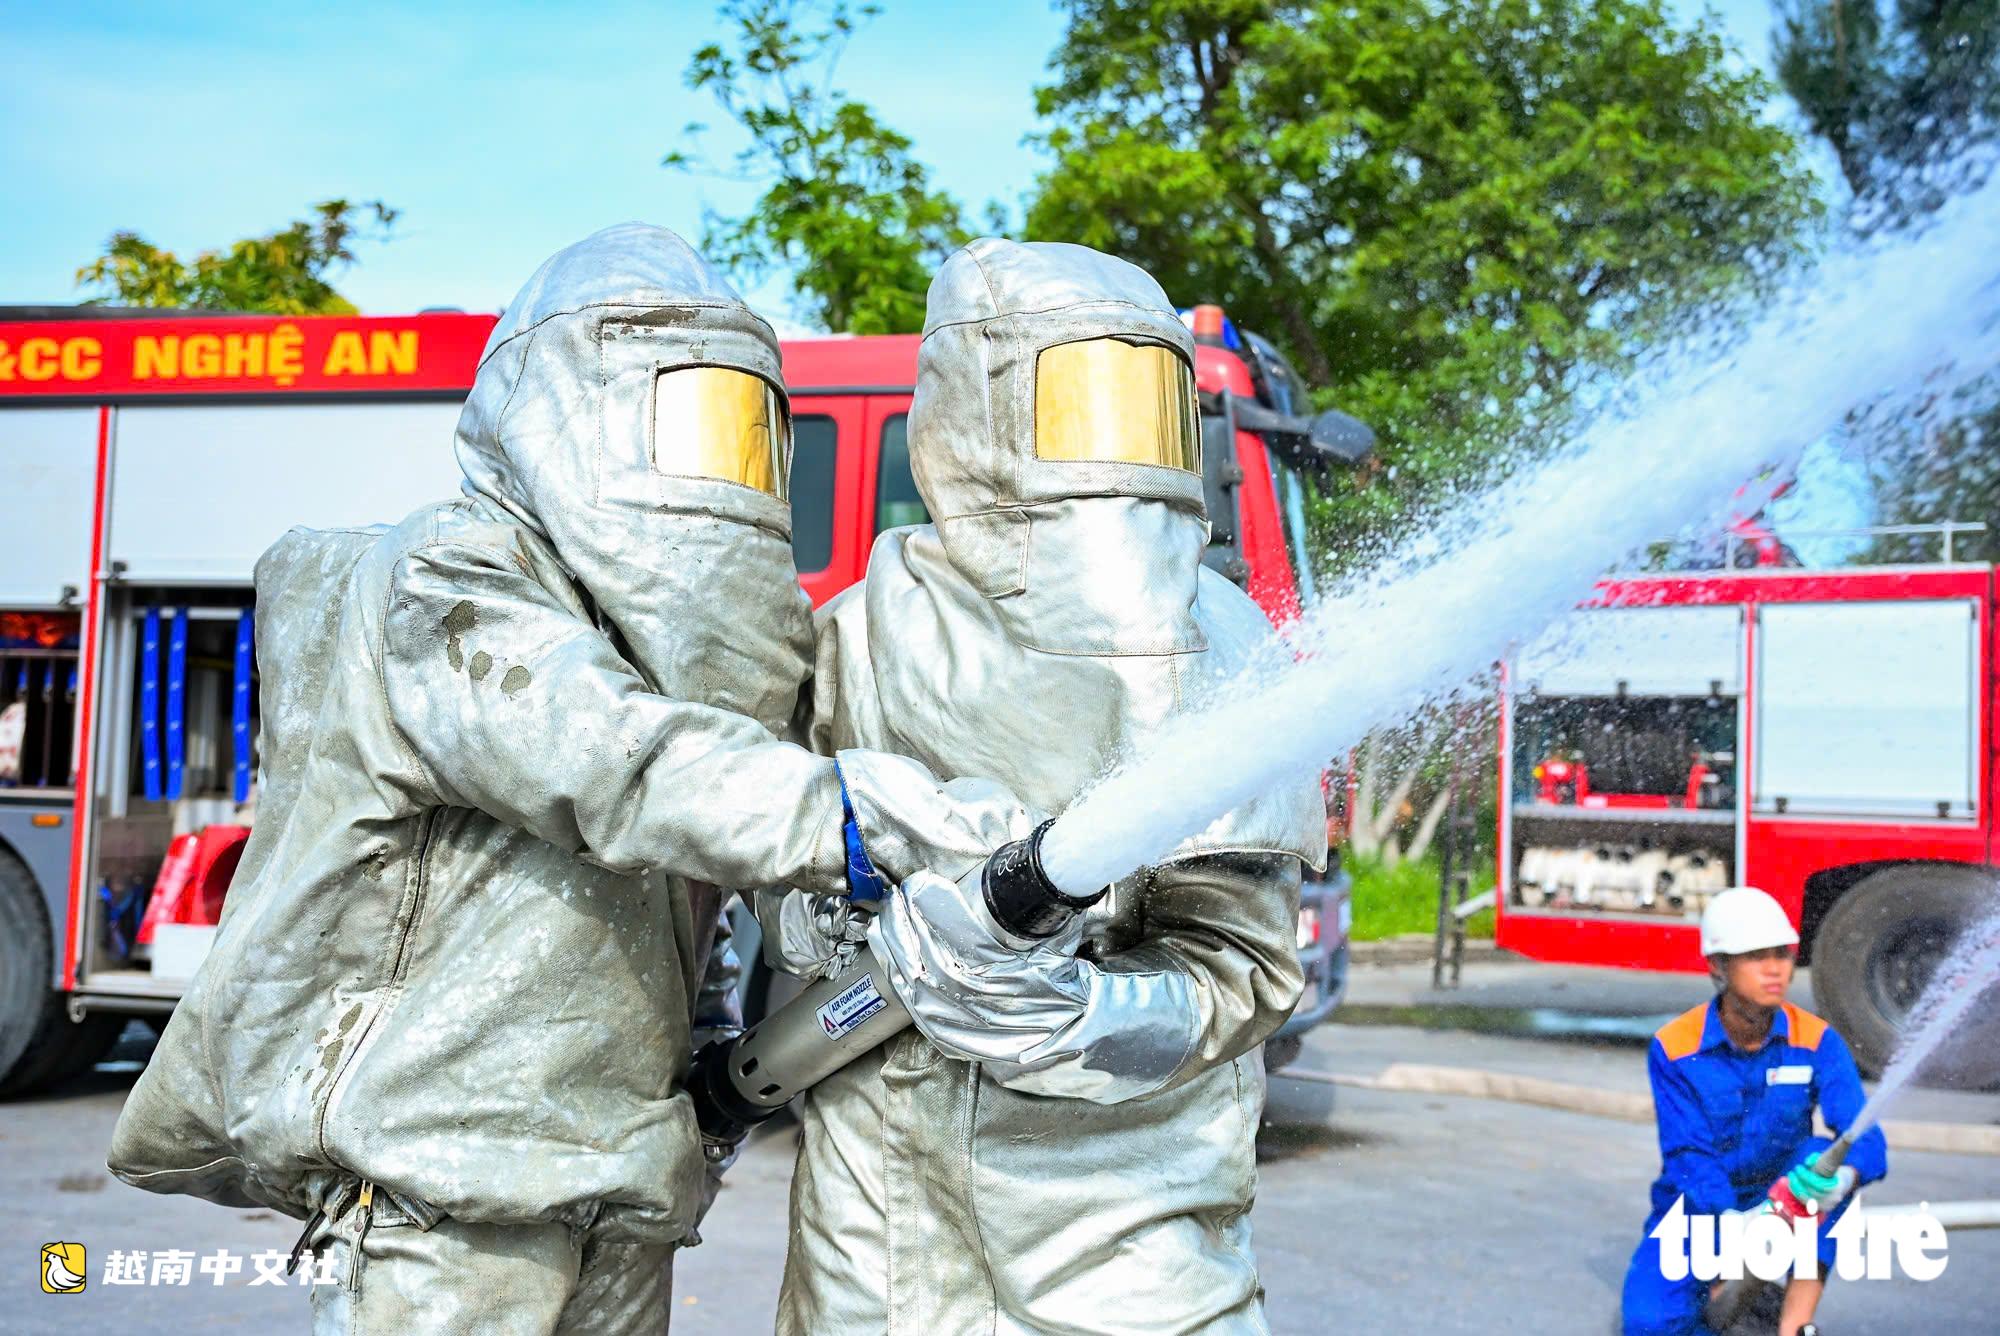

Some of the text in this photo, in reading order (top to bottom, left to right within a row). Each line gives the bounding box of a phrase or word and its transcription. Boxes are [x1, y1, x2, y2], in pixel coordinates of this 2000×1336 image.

[133, 322, 305, 386] NGHỆ
[323, 330, 419, 376] AN
[831, 1000, 841, 1013] AIR
[840, 991, 854, 1006] FOAM
[853, 978, 871, 997] NOZZLE
